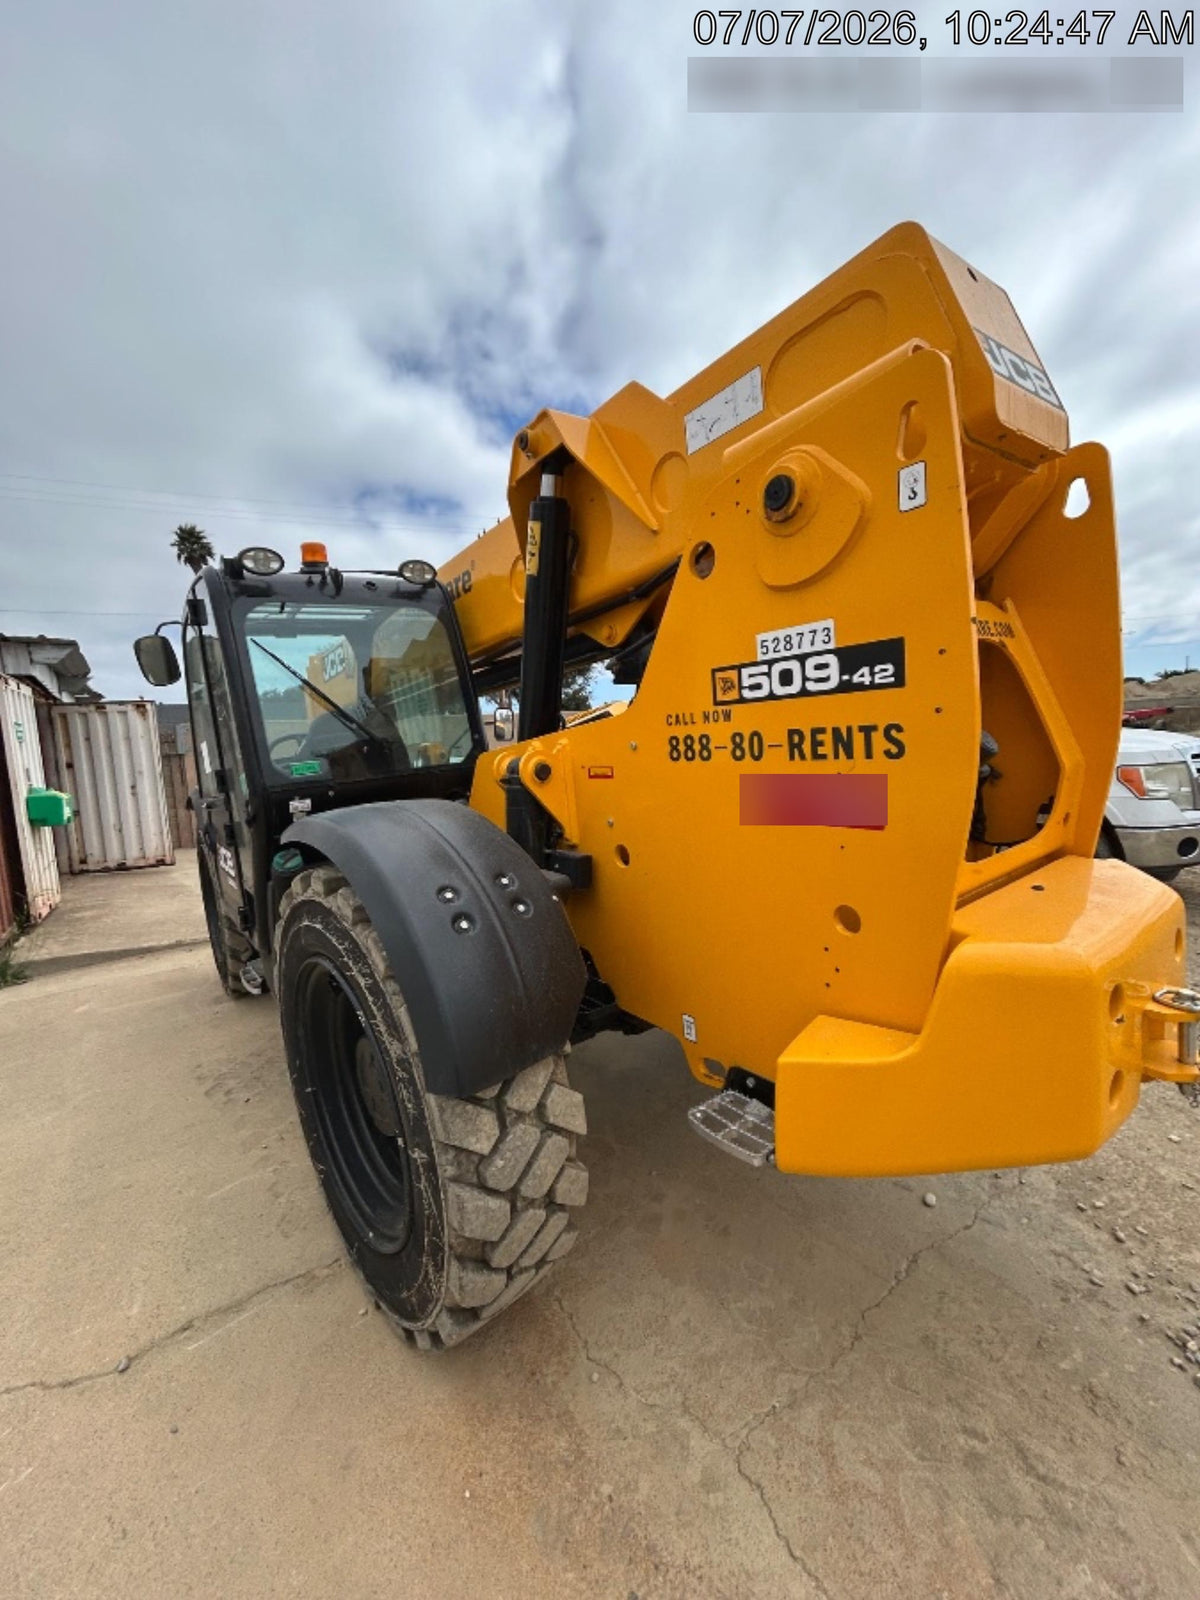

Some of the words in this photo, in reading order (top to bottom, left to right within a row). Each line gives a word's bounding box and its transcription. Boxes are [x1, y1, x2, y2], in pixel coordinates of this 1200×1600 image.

[760, 626, 832, 656] 528773
[740, 653, 896, 699] 509-42
[666, 711, 697, 726] CALL
[703, 708, 732, 724] NOW
[668, 722, 906, 762] 888-80-RENTS
